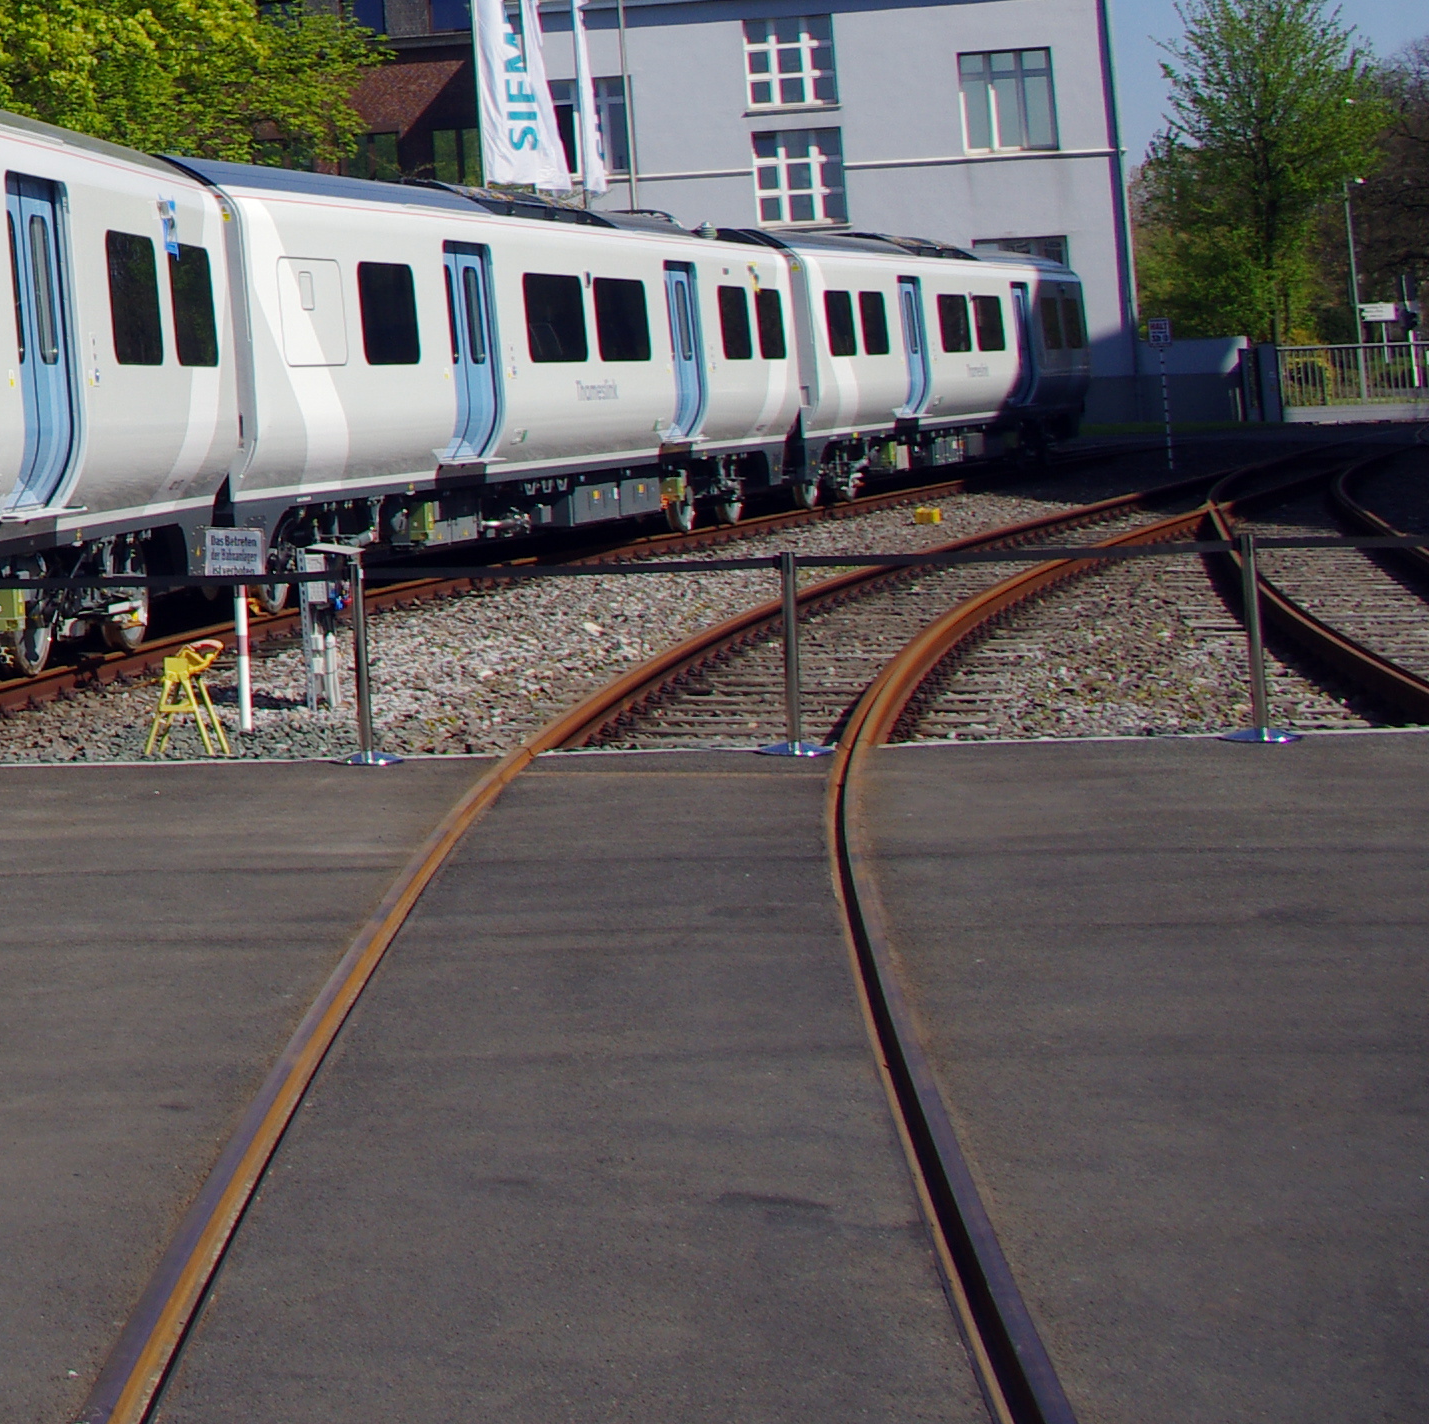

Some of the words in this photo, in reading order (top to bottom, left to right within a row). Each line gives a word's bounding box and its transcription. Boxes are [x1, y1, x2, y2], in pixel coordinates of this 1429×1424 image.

[503, 6, 540, 151] SIEM
[210, 534, 224, 546] Das
[224, 534, 257, 547] Betreten
[210, 547, 221, 561] der
